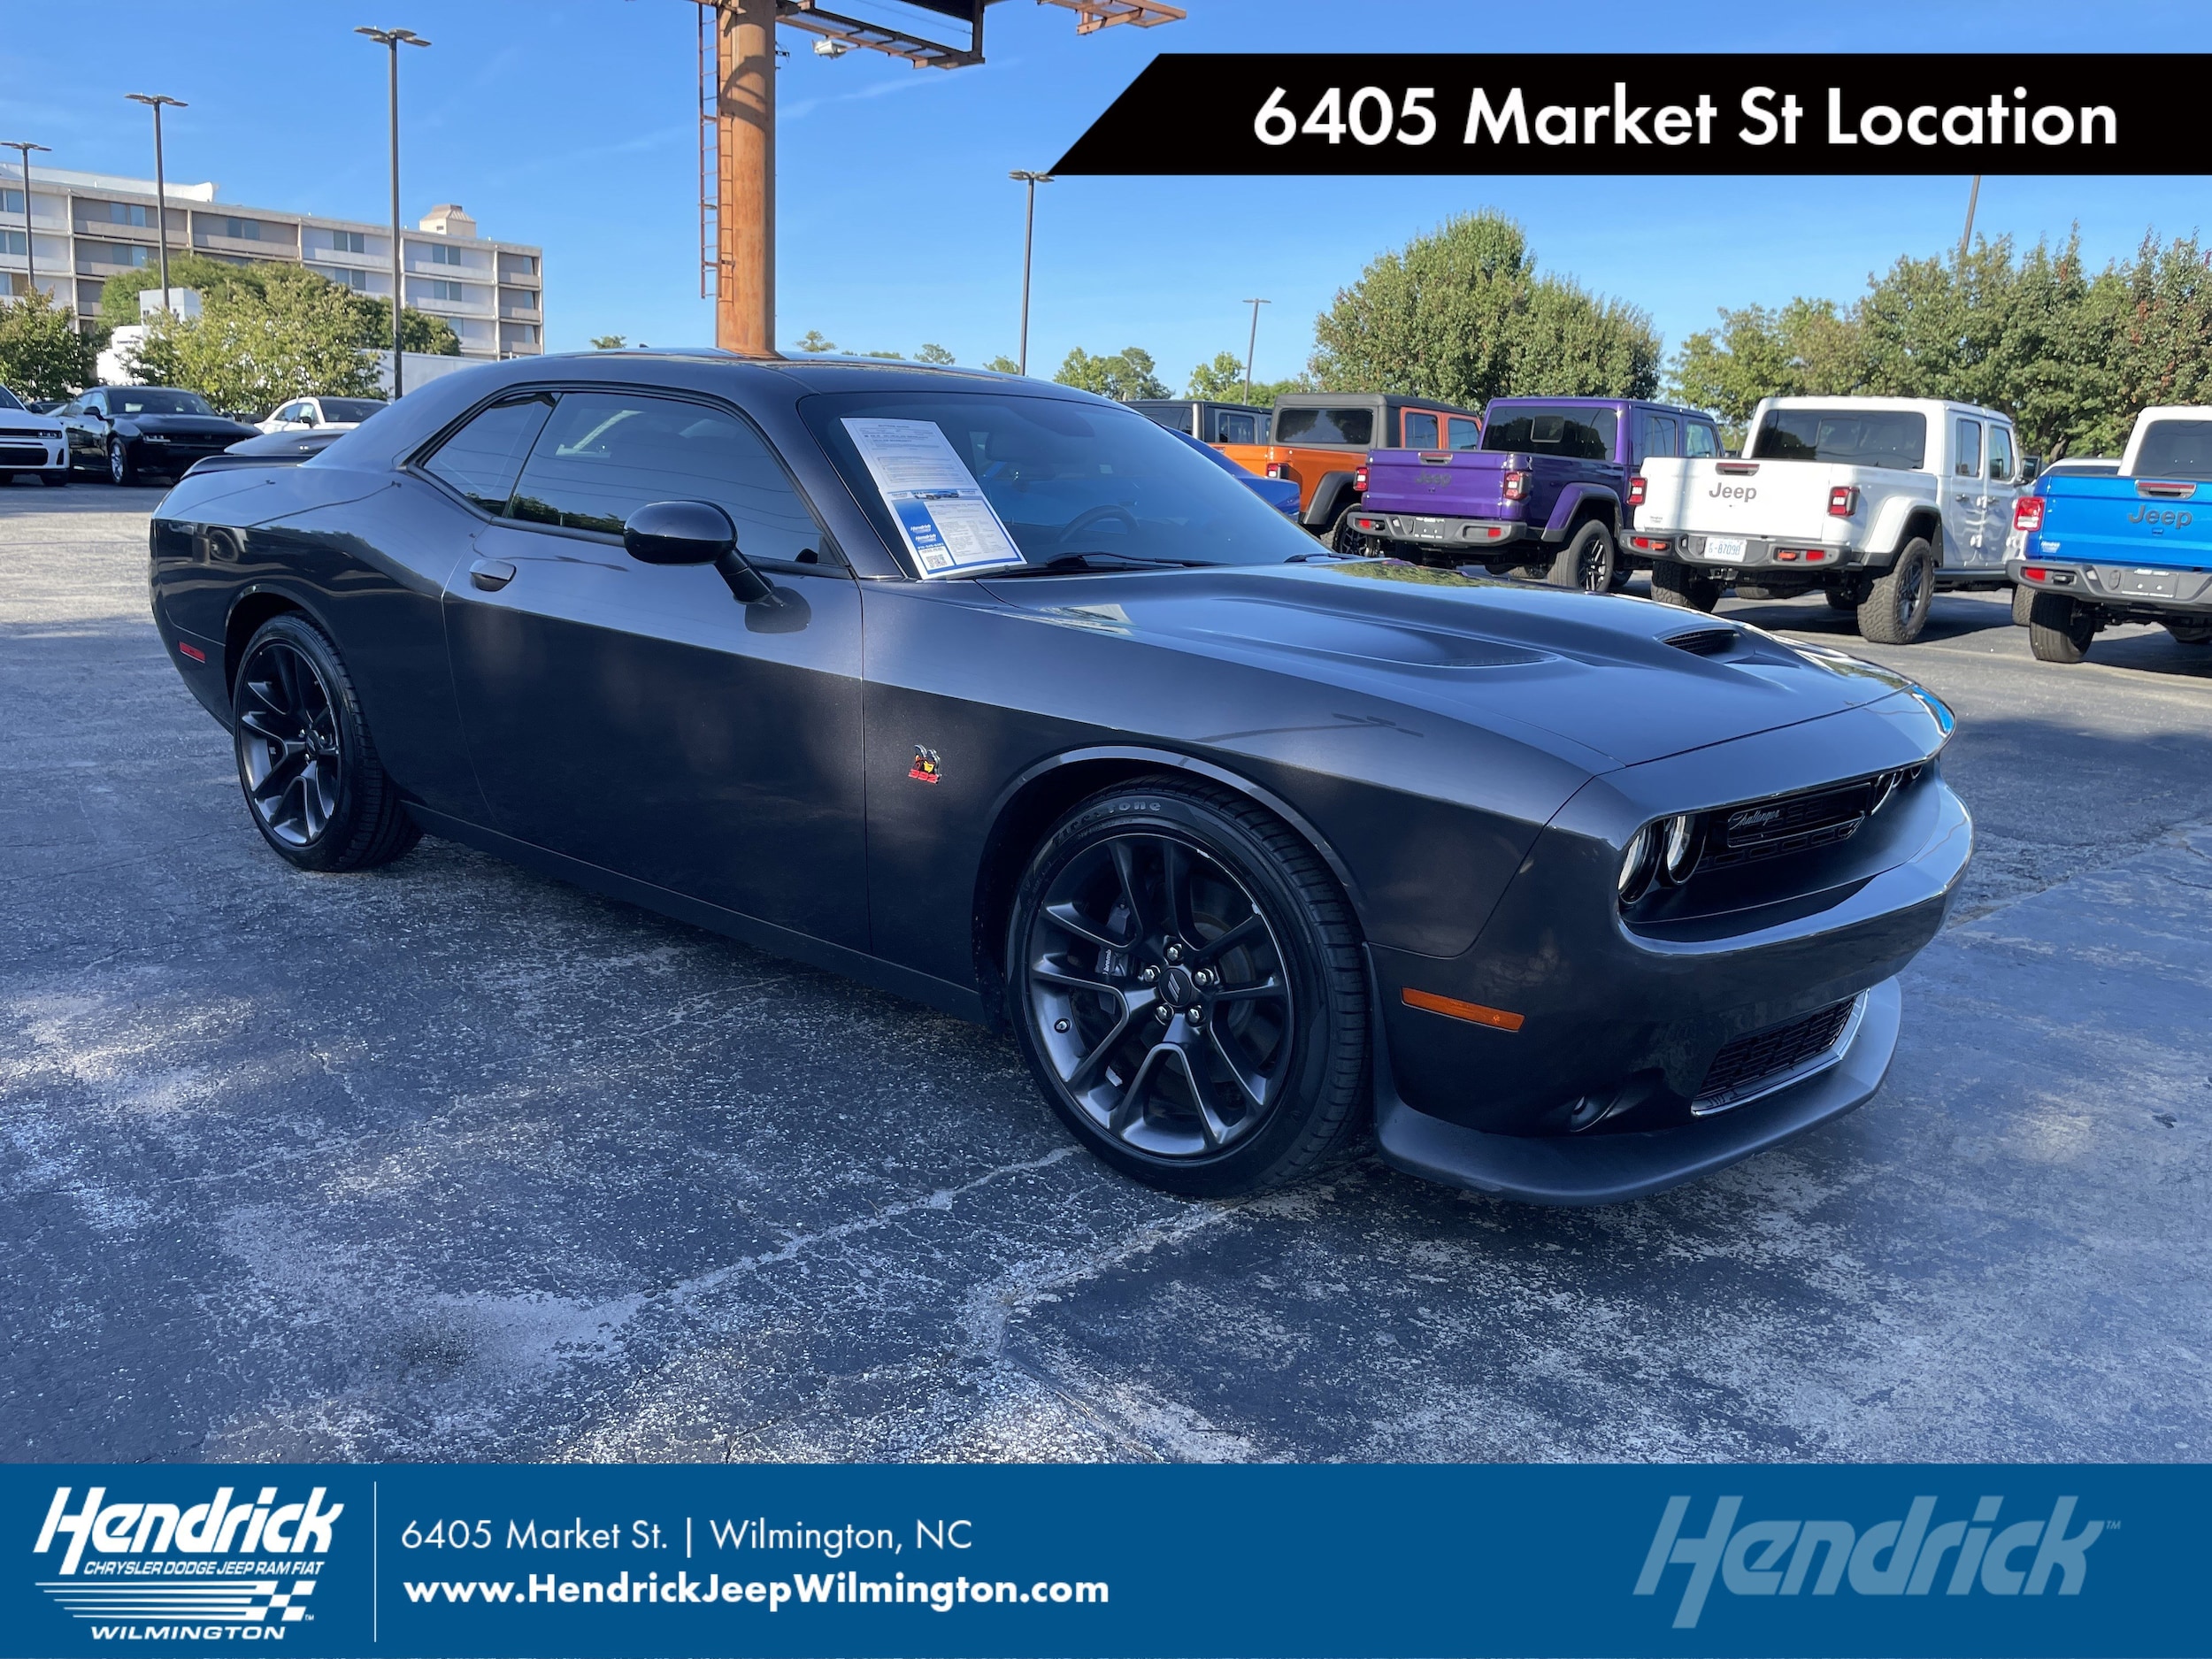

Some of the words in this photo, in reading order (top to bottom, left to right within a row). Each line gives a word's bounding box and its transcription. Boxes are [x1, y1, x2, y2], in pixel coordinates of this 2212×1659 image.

[1416, 469, 1452, 488] Jeep
[1709, 481, 1757, 503] Jeep
[2127, 503, 2193, 529] Jeep
[1728, 809, 1780, 831] Challenger
[1102, 949, 1112, 972] bremb
